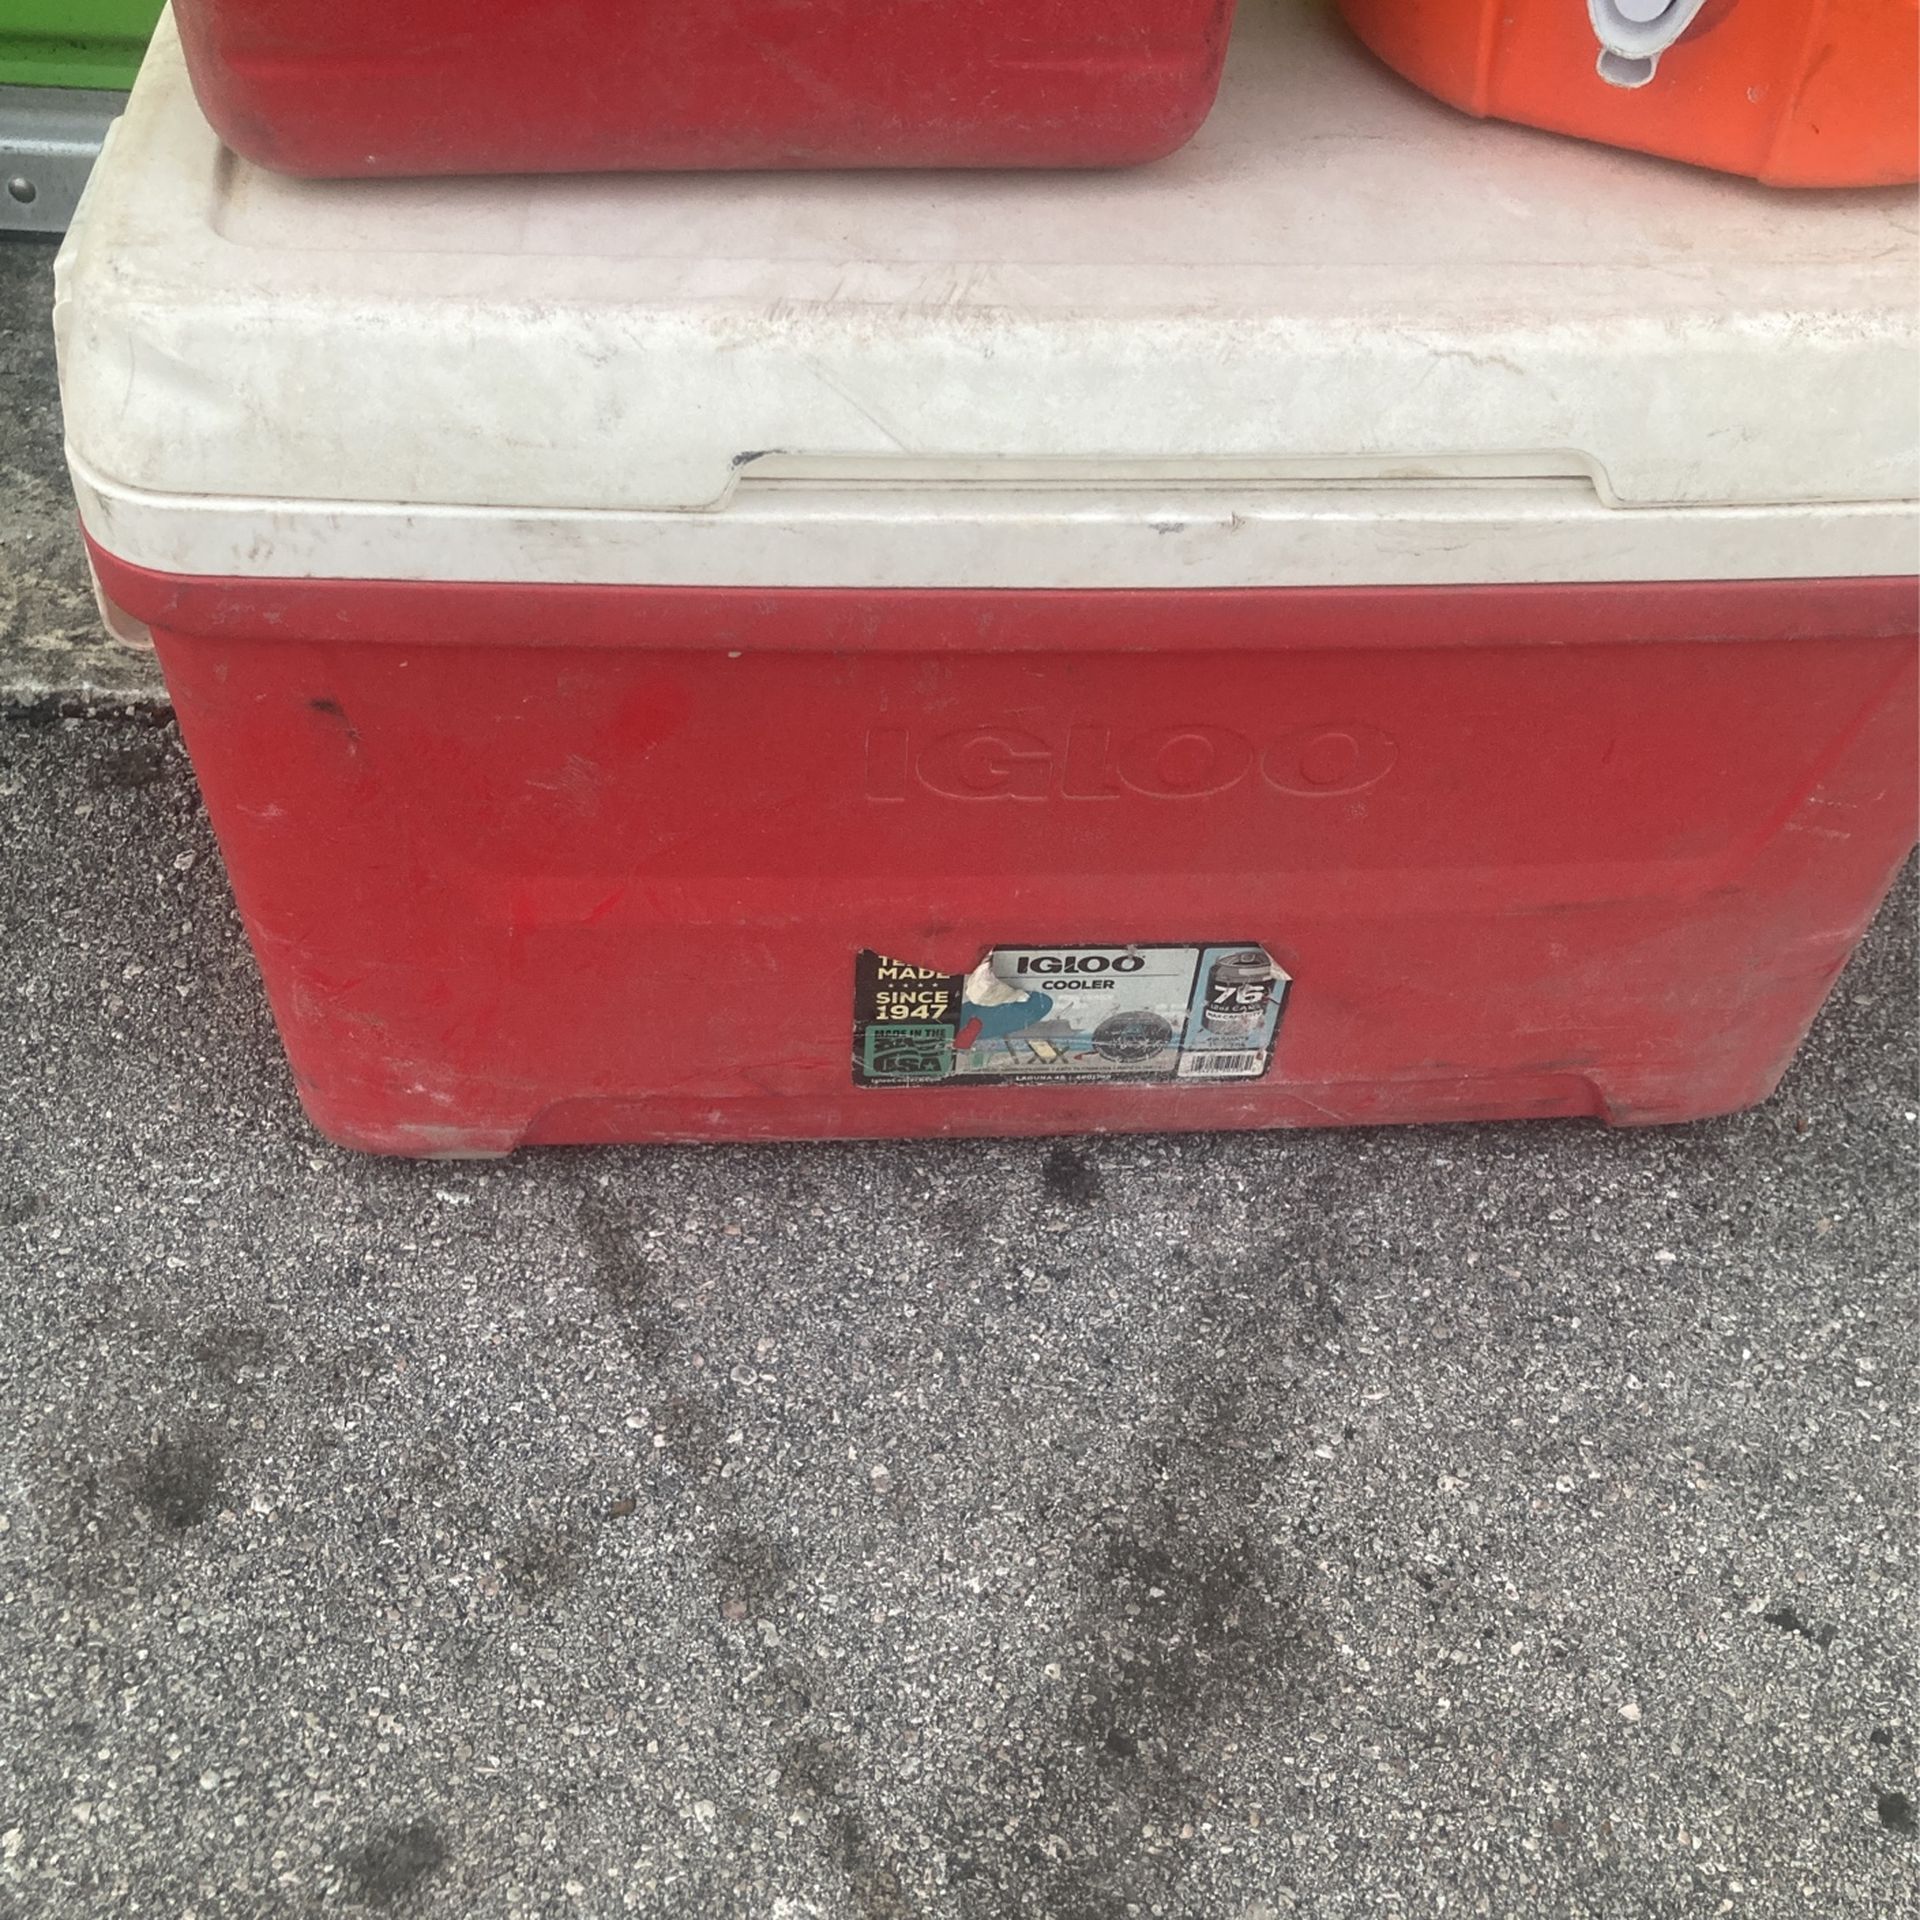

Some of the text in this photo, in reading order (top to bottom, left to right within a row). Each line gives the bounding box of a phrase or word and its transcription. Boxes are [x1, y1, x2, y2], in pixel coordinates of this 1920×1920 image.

[865, 724, 1398, 802] IGLOO
[1017, 955, 1146, 974] IGLOO
[1041, 980, 1115, 990] COOLER
[876, 991, 949, 1004] SINCE
[1214, 984, 1265, 1004] 76
[876, 1004, 948, 1020] 1947
[910, 1029, 922, 1037] IN
[924, 1028, 946, 1038] THE
[873, 1057, 942, 1073] USA
